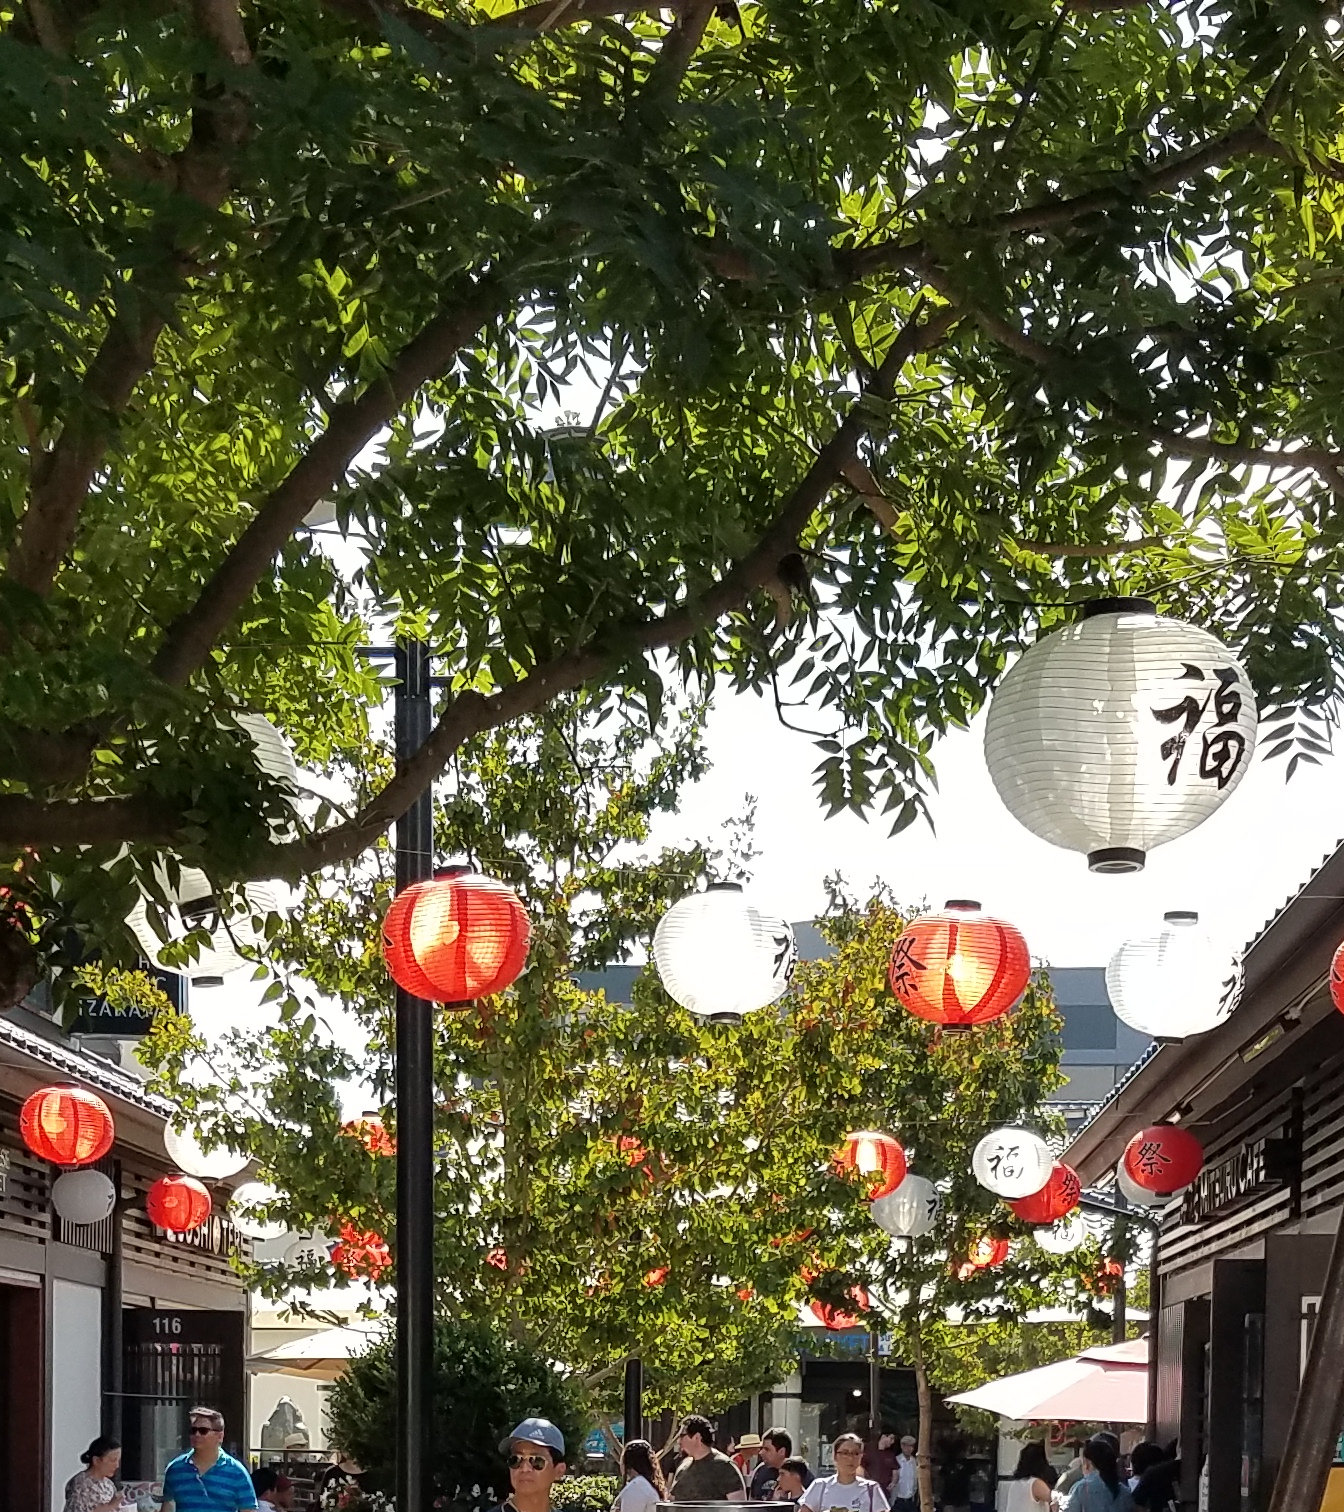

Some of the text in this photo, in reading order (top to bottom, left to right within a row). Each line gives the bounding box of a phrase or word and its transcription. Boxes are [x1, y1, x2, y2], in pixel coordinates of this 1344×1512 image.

[1150, 662, 1246, 790] 福
[892, 937, 927, 997] 祭
[79, 1000, 162, 1018] IZAKA
[988, 1145, 1025, 1180] 福
[1133, 1142, 1172, 1176] 祭
[1059, 1171, 1080, 1206] 祭
[152, 1317, 182, 1334] 116
